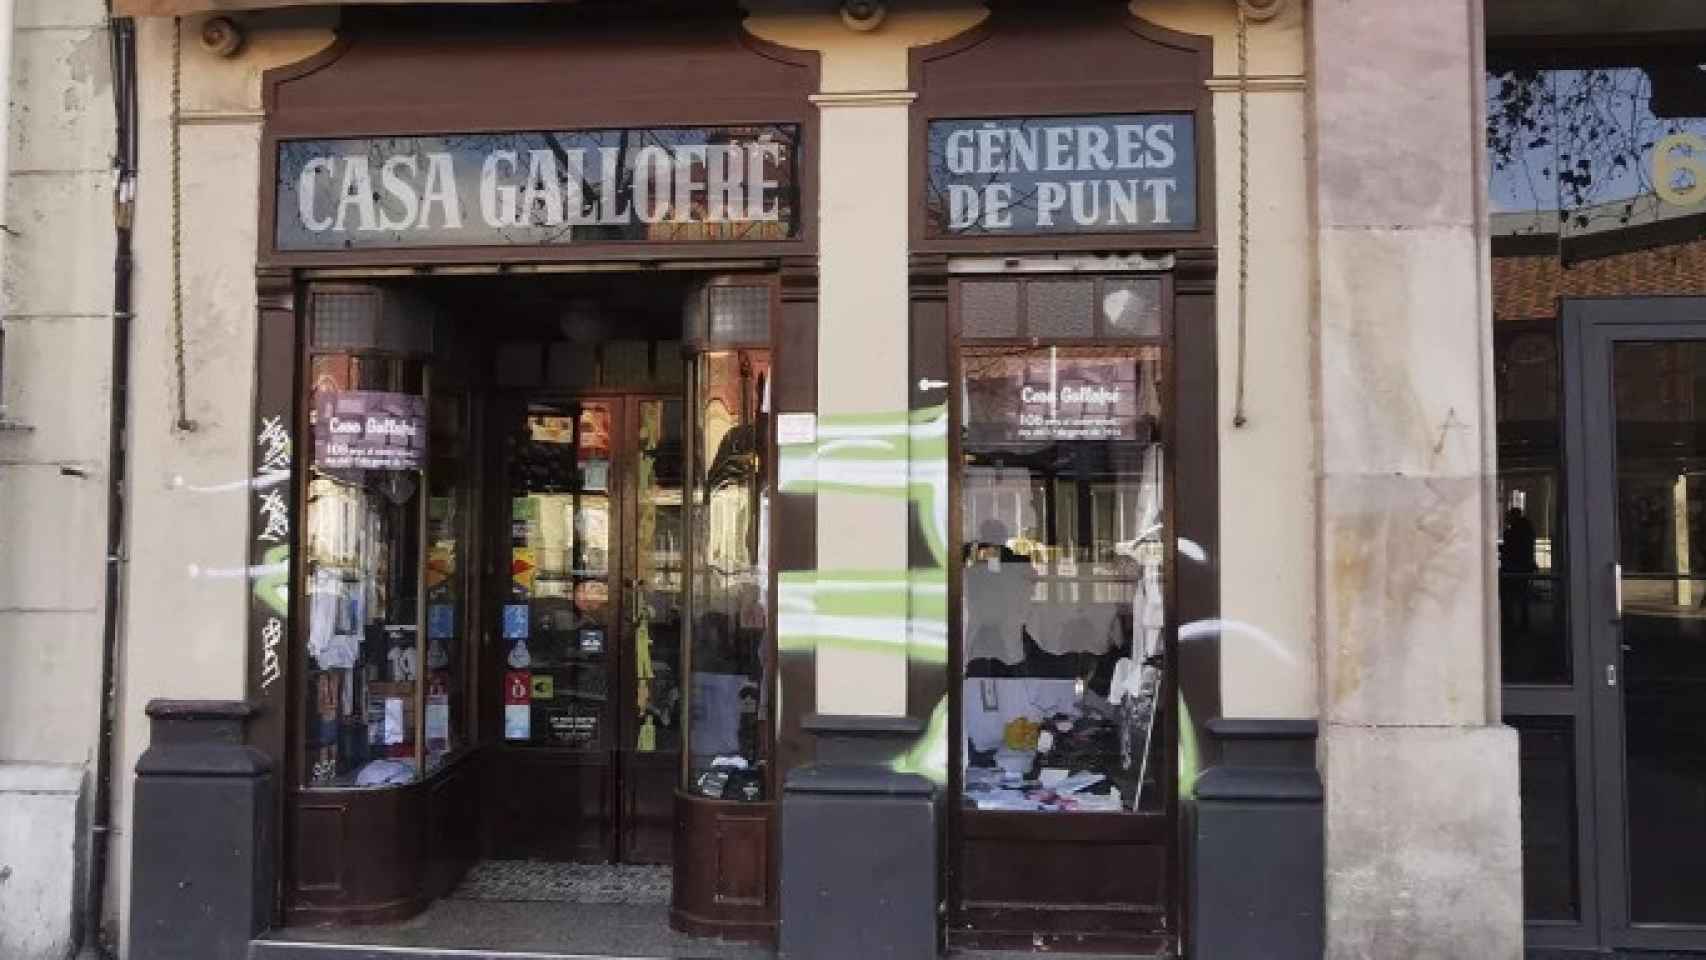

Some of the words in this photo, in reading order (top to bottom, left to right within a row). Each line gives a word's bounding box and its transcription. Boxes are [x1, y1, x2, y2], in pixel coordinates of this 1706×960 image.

[299, 152, 463, 231] CASA
[947, 182, 1012, 229] DE
[1034, 179, 1176, 226] PUNT
[1652, 134, 1706, 208] 6
